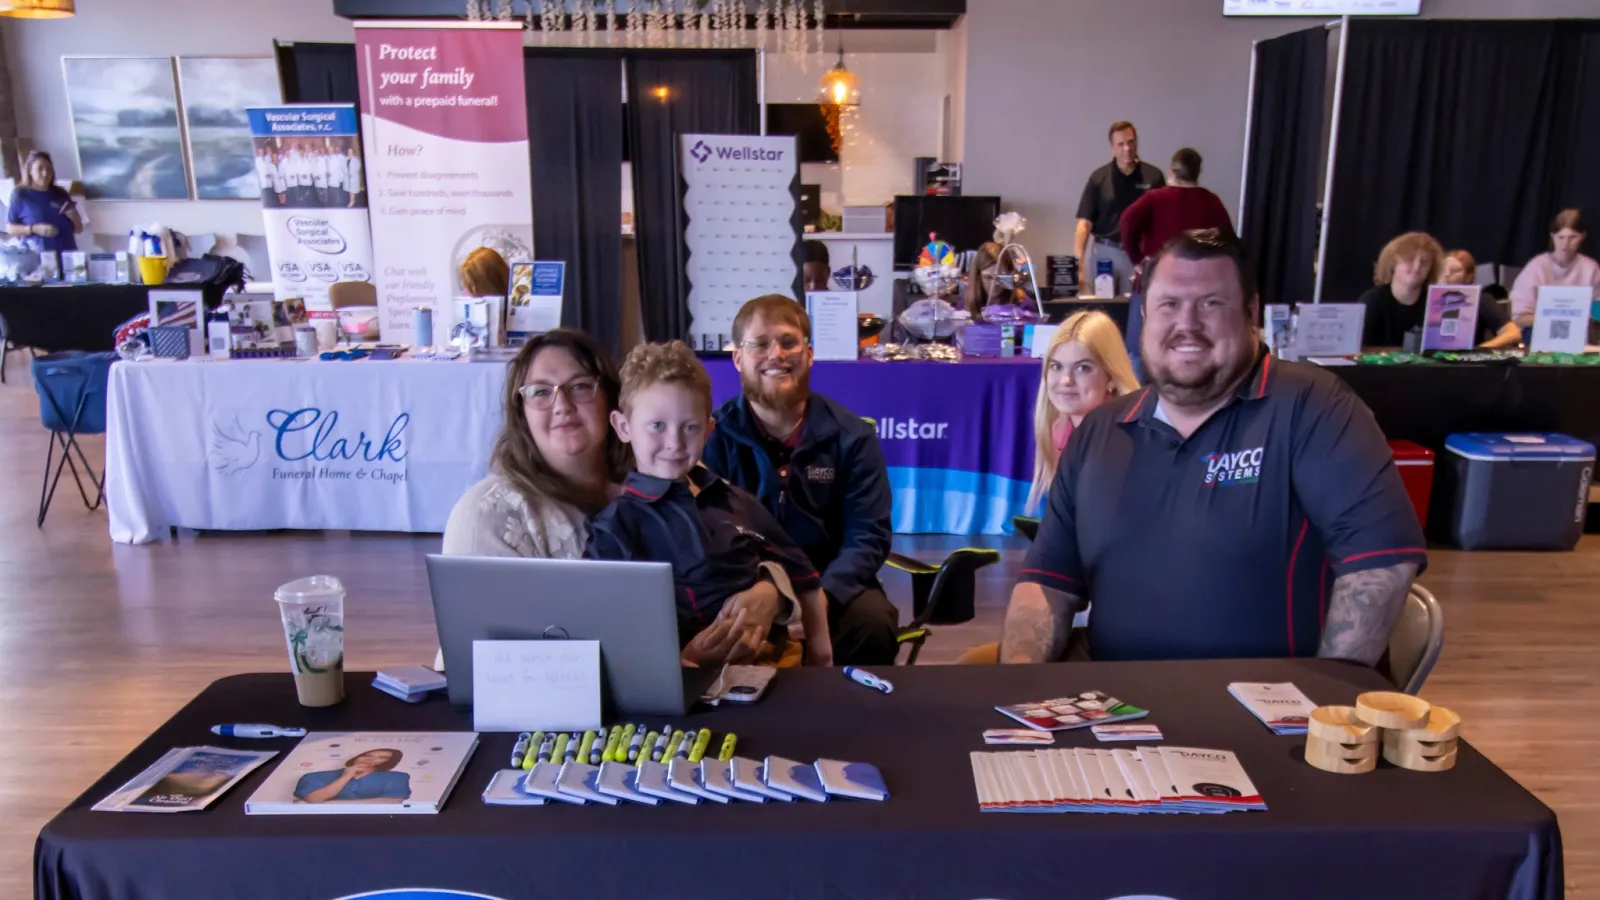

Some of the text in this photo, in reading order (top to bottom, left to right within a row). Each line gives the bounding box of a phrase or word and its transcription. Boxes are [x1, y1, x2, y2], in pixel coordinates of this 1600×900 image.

[379, 44, 437, 60] Protect
[379, 66, 475, 90] your family
[379, 96, 403, 106] with
[405, 98, 412, 106] a
[414, 95, 456, 108] prepaid
[265, 111, 336, 123] Vascular Surgical
[387, 145, 424, 156] How?
[716, 146, 784, 161] Wellstar
[410, 209, 434, 218] peace
[436, 207, 445, 216] of
[296, 228, 328, 237] Surgical
[277, 263, 299, 272] VSA
[309, 263, 331, 272] VSA
[341, 263, 363, 272] VSA
[876, 416, 949, 440] llstar
[266, 407, 410, 462] Clark
[272, 467, 408, 484] Funeral Home & Chapel
